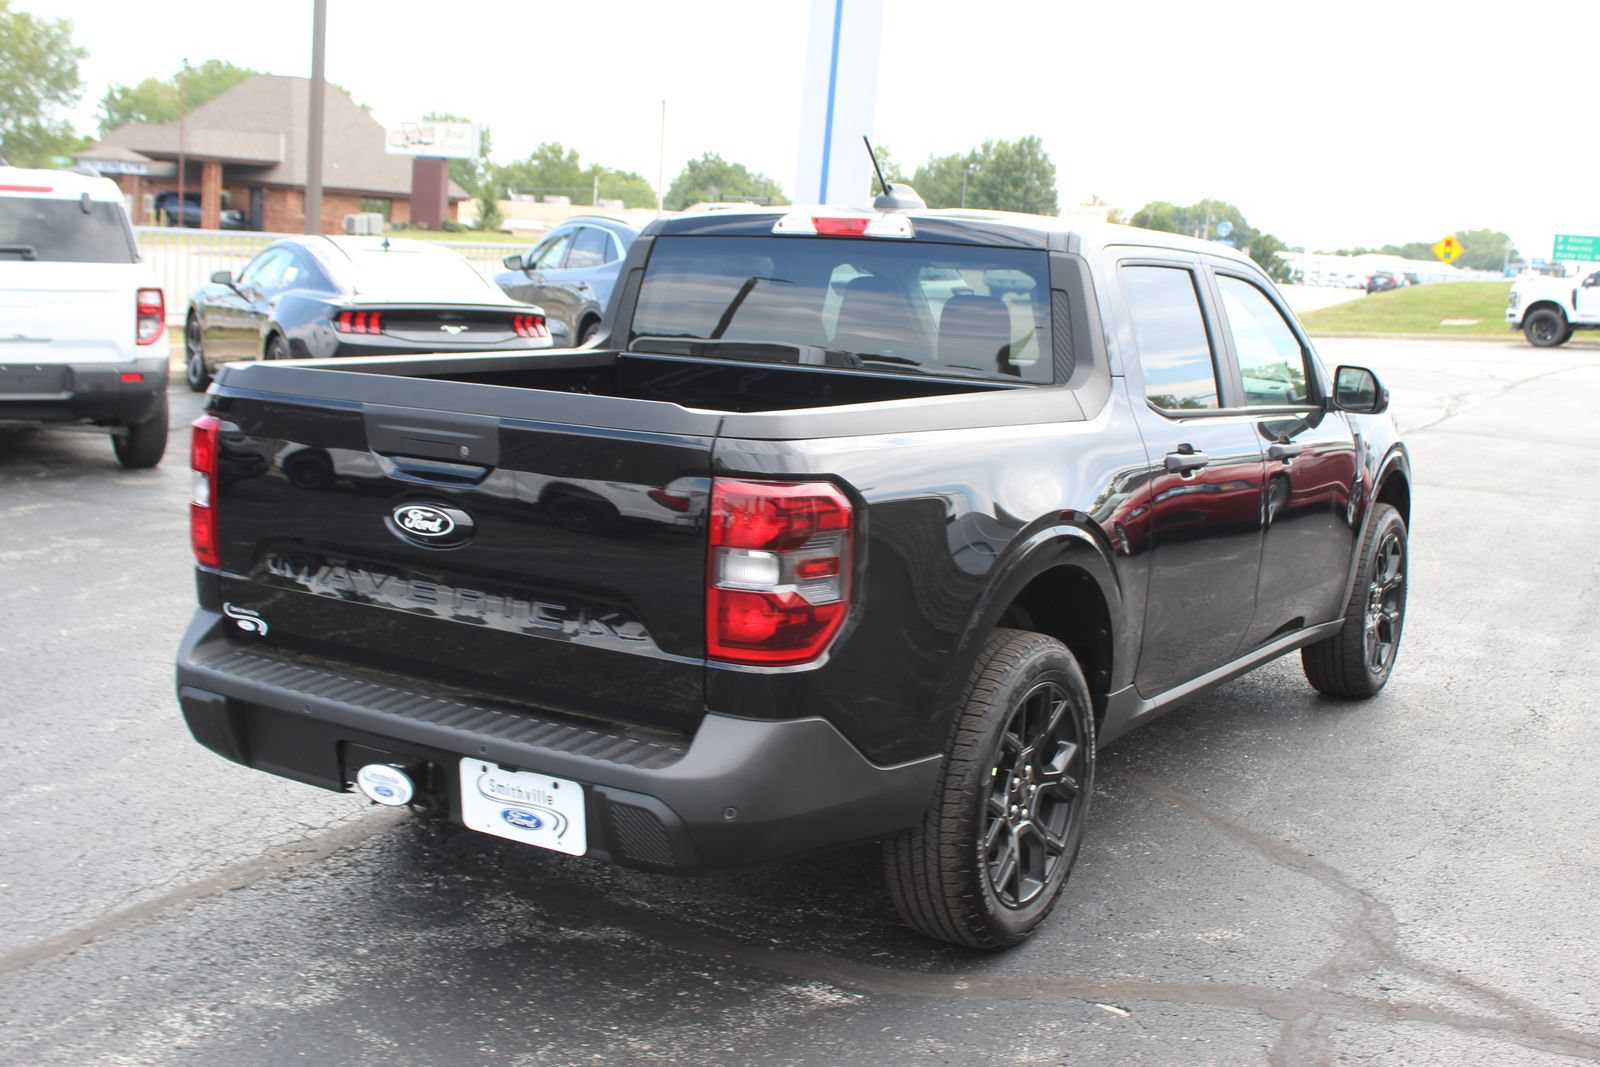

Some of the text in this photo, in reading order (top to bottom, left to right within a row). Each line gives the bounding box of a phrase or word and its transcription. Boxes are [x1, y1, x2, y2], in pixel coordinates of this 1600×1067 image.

[404, 509, 443, 532] Ford
[270, 556, 620, 637] MAVERICK
[489, 778, 554, 806] Smithville
[506, 811, 538, 828] Ford
